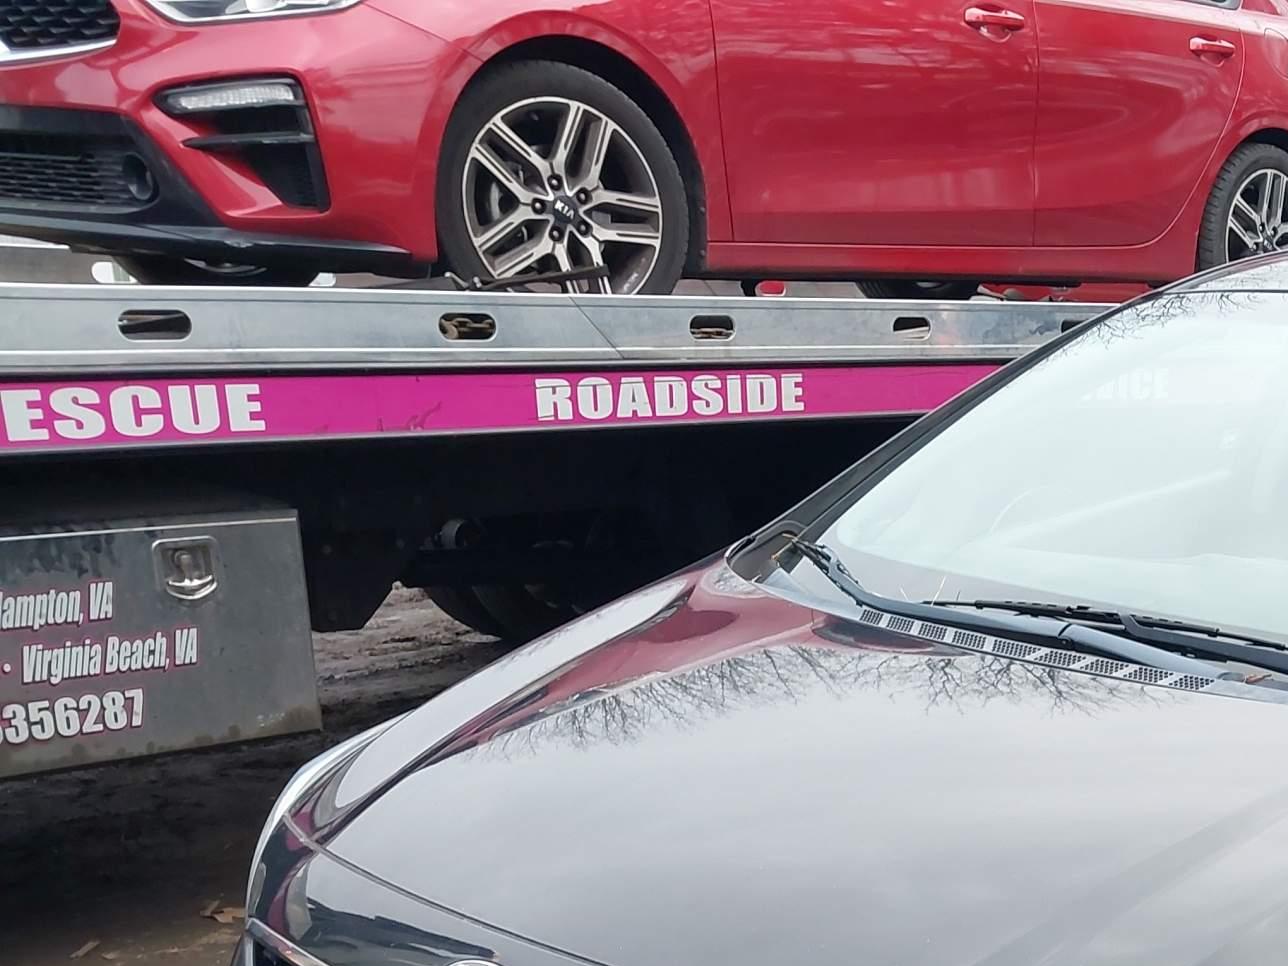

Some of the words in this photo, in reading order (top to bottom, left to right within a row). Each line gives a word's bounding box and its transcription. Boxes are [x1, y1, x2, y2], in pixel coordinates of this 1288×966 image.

[554, 200, 575, 219] KIA
[0, 384, 266, 442] ESCUE
[535, 373, 805, 421] ROADSIDE
[89, 581, 113, 621] VA
[23, 639, 102, 684] Virginia
[105, 632, 170, 671] Beach,
[174, 627, 198, 666] VA
[0, 688, 144, 744] 356287
